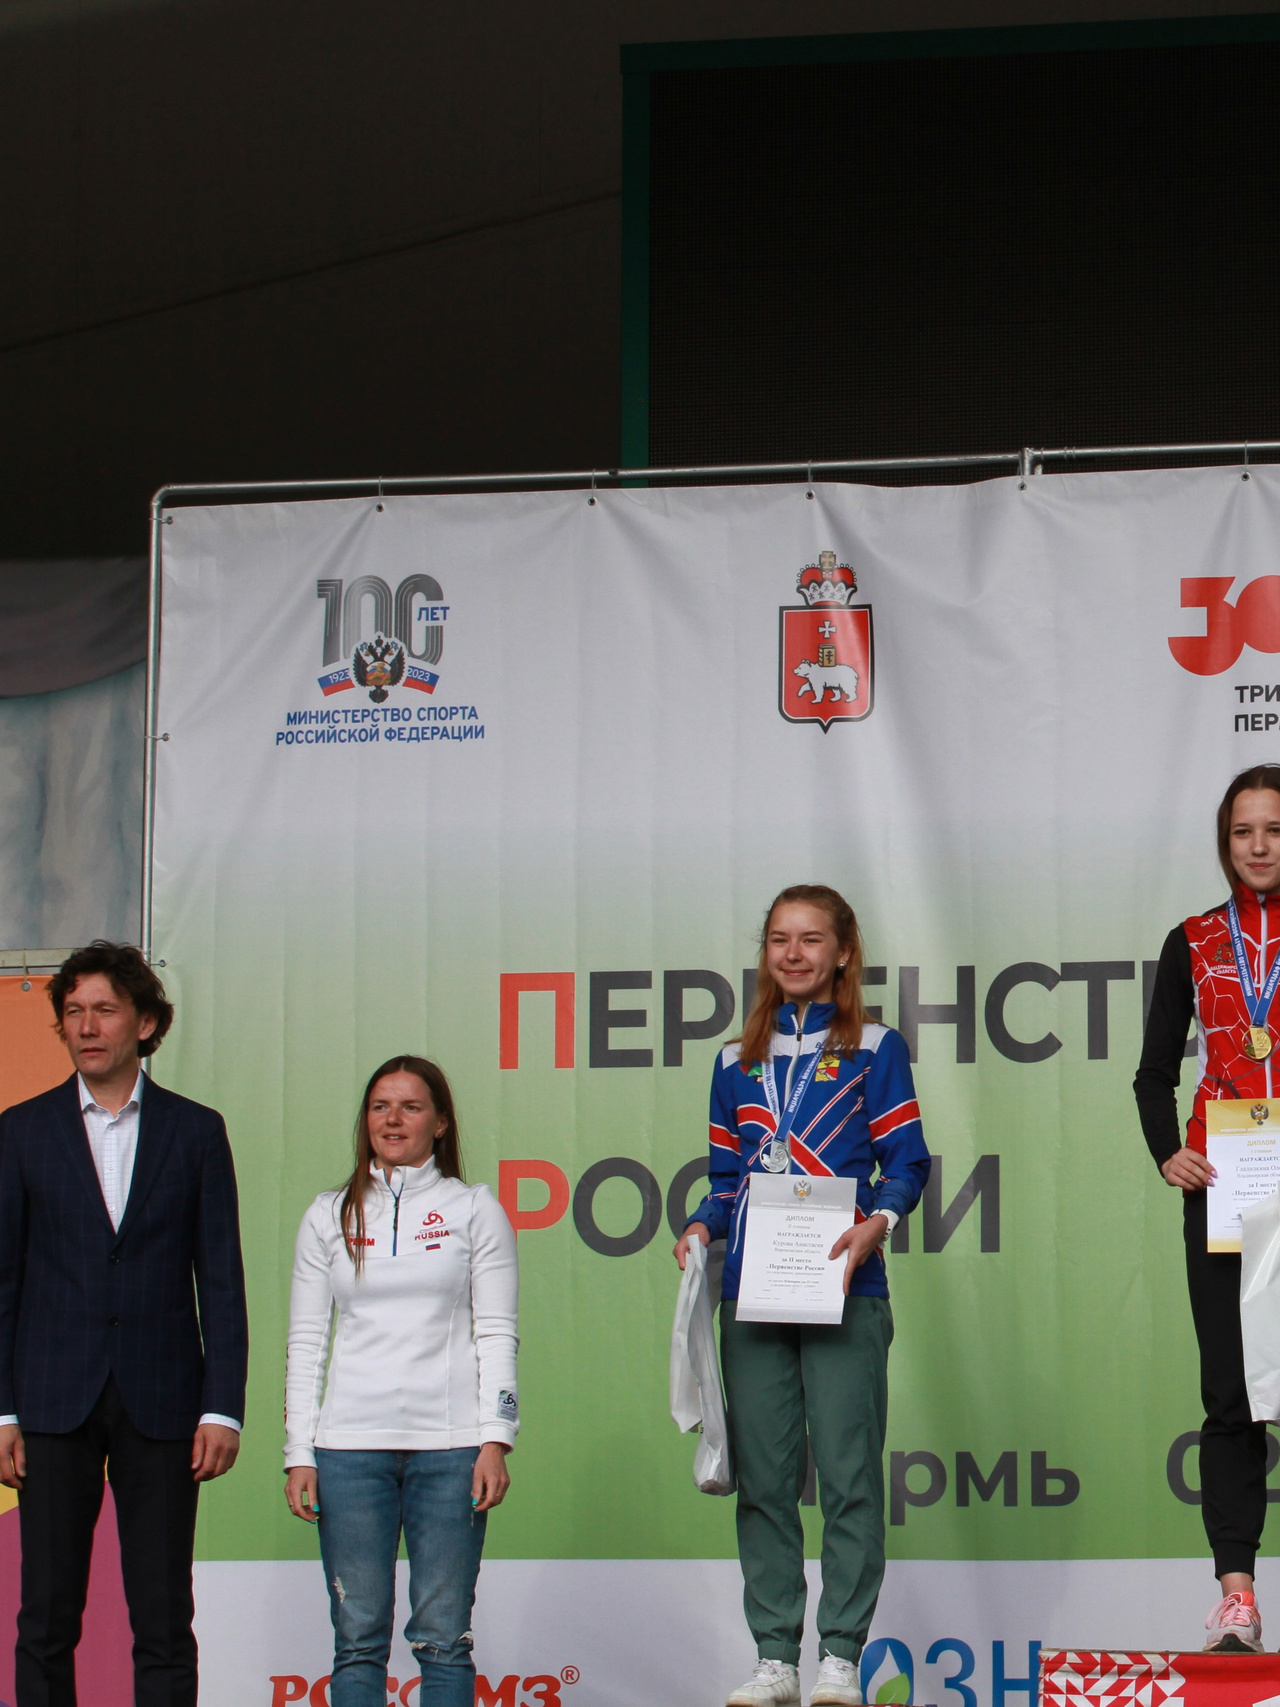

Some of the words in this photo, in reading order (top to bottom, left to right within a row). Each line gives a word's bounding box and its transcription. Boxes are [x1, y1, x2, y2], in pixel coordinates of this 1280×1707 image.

[316, 573, 444, 668] 100
[417, 606, 449, 621] ЛЕТ
[328, 670, 350, 684] 1923
[408, 668, 430, 682] 2023
[286, 708, 412, 726] МИНИСТЕРСТВО
[417, 706, 479, 721] СПОРТА
[275, 725, 379, 746] РОССИЙСКОЙ
[384, 725, 485, 743] ФЕДЕРАЦИИ
